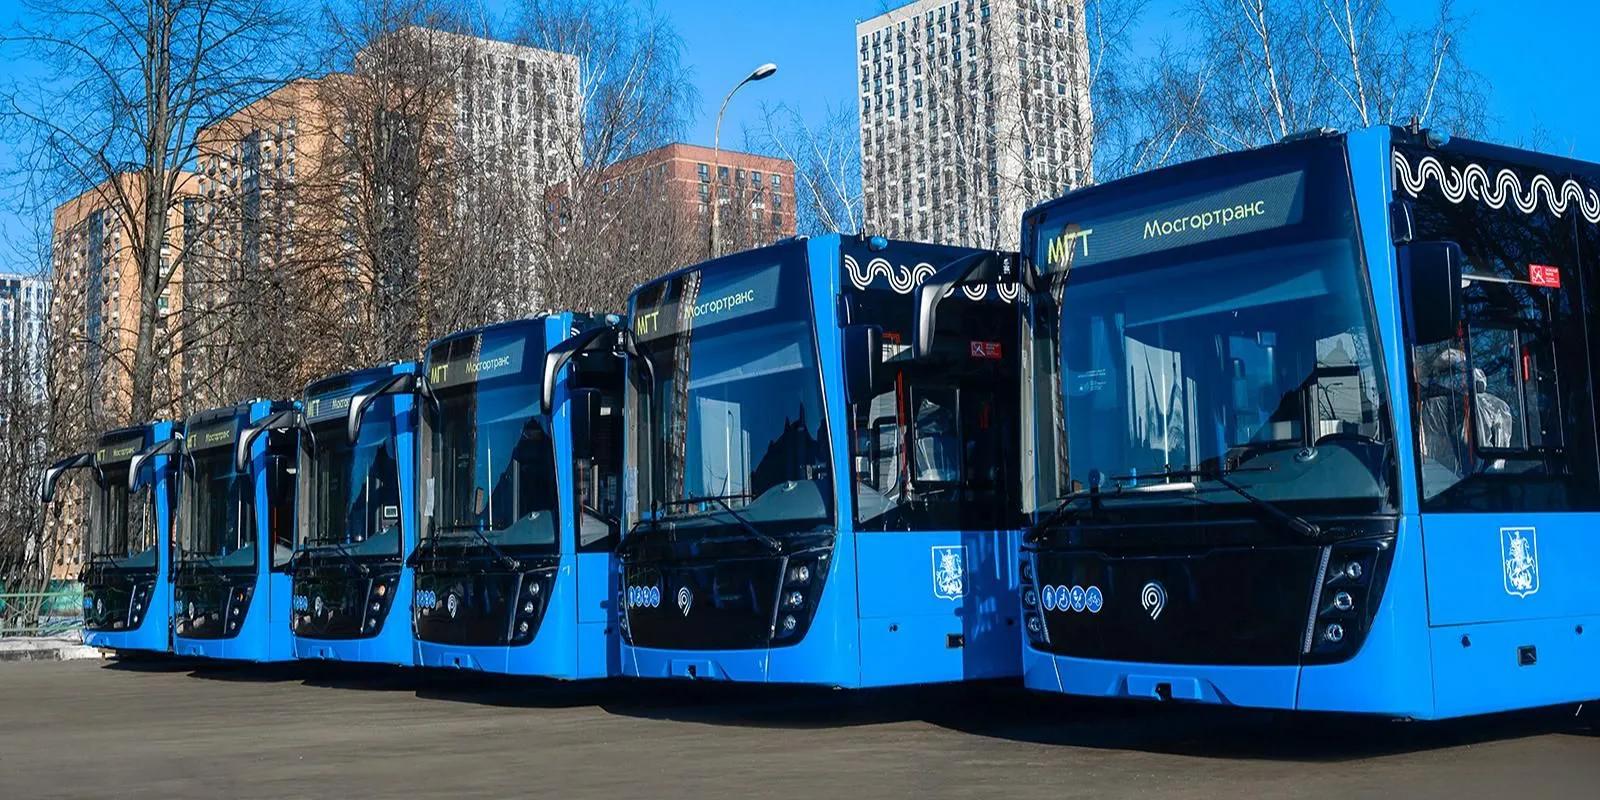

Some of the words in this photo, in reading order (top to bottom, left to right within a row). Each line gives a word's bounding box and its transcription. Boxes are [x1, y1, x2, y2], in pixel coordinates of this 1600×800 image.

[1047, 228, 1093, 266] МГТ
[1143, 200, 1265, 240] Мосгортранс
[637, 311, 659, 336] МГТ
[684, 289, 754, 319] Мосгортранс
[430, 364, 449, 384] МГТ
[465, 355, 510, 374] Мосгортранс
